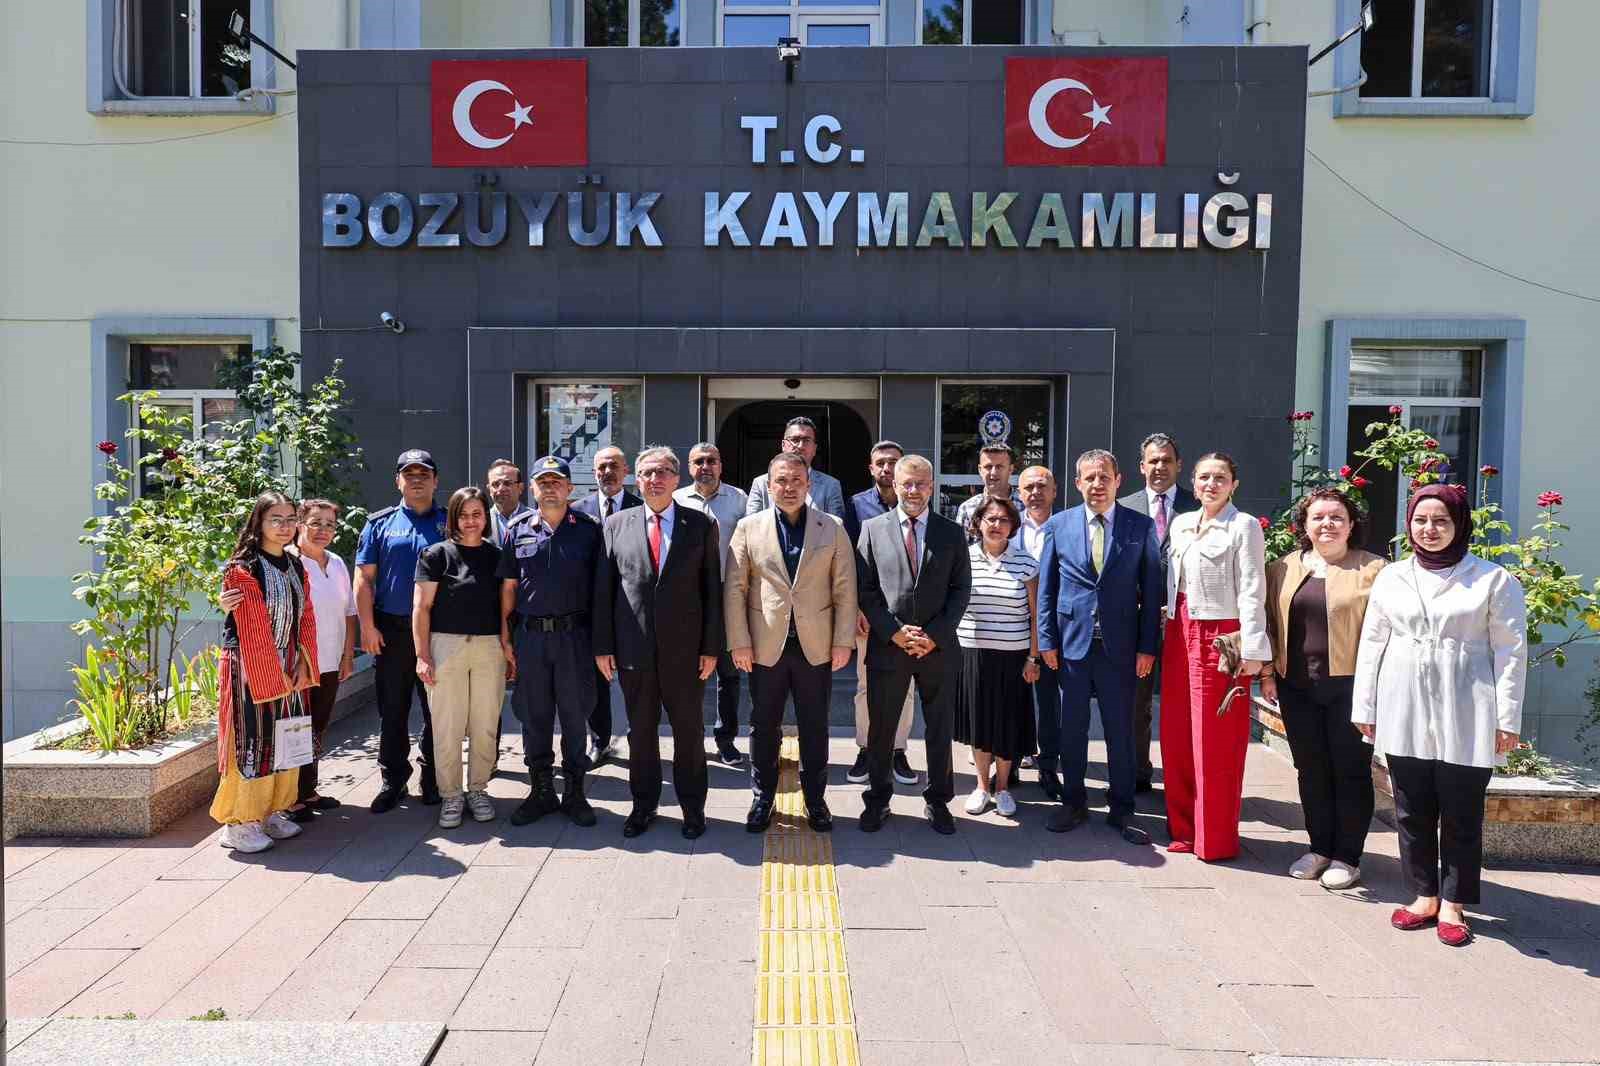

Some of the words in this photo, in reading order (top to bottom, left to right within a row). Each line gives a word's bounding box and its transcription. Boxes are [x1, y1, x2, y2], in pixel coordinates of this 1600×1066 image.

[741, 114, 864, 164] T.C.
[322, 175, 663, 248] BOZÜYÜK
[704, 172, 1272, 249] KAYMAKAMLIĞI
